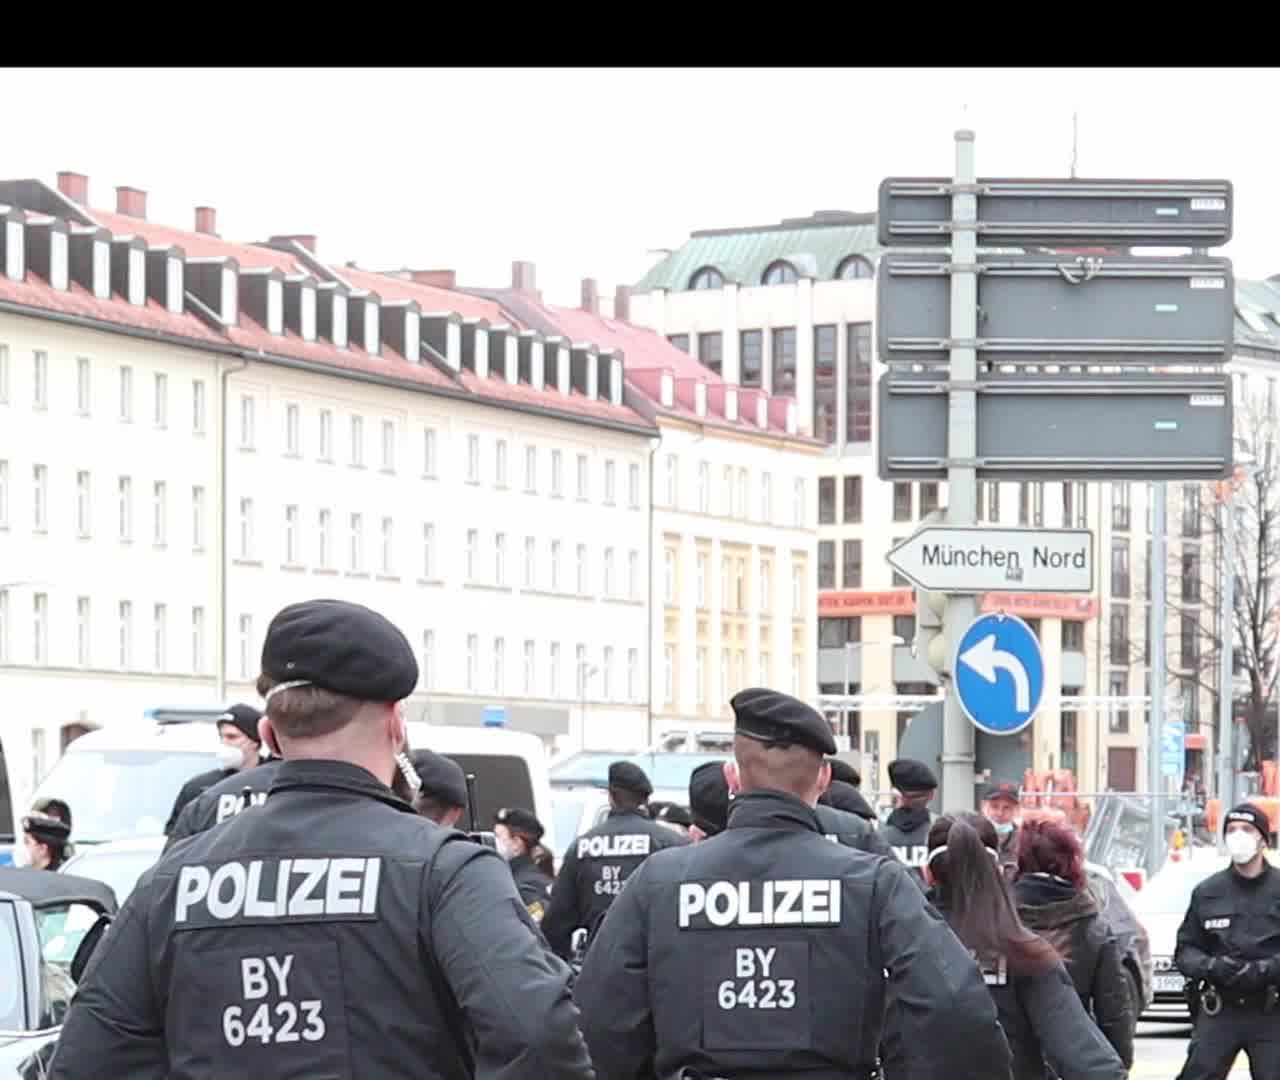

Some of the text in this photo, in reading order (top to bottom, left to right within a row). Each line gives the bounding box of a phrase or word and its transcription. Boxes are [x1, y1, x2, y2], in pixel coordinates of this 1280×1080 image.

[922, 545, 1086, 569] München Nord
[577, 834, 651, 859] POLIZEI
[601, 865, 622, 880] BY
[175, 857, 380, 922] POLIZEI
[678, 879, 841, 928] POLIZEI
[240, 955, 295, 1000] BY
[735, 947, 777, 977] BY
[717, 978, 796, 1010] 6423
[222, 1000, 326, 1048] 6423
